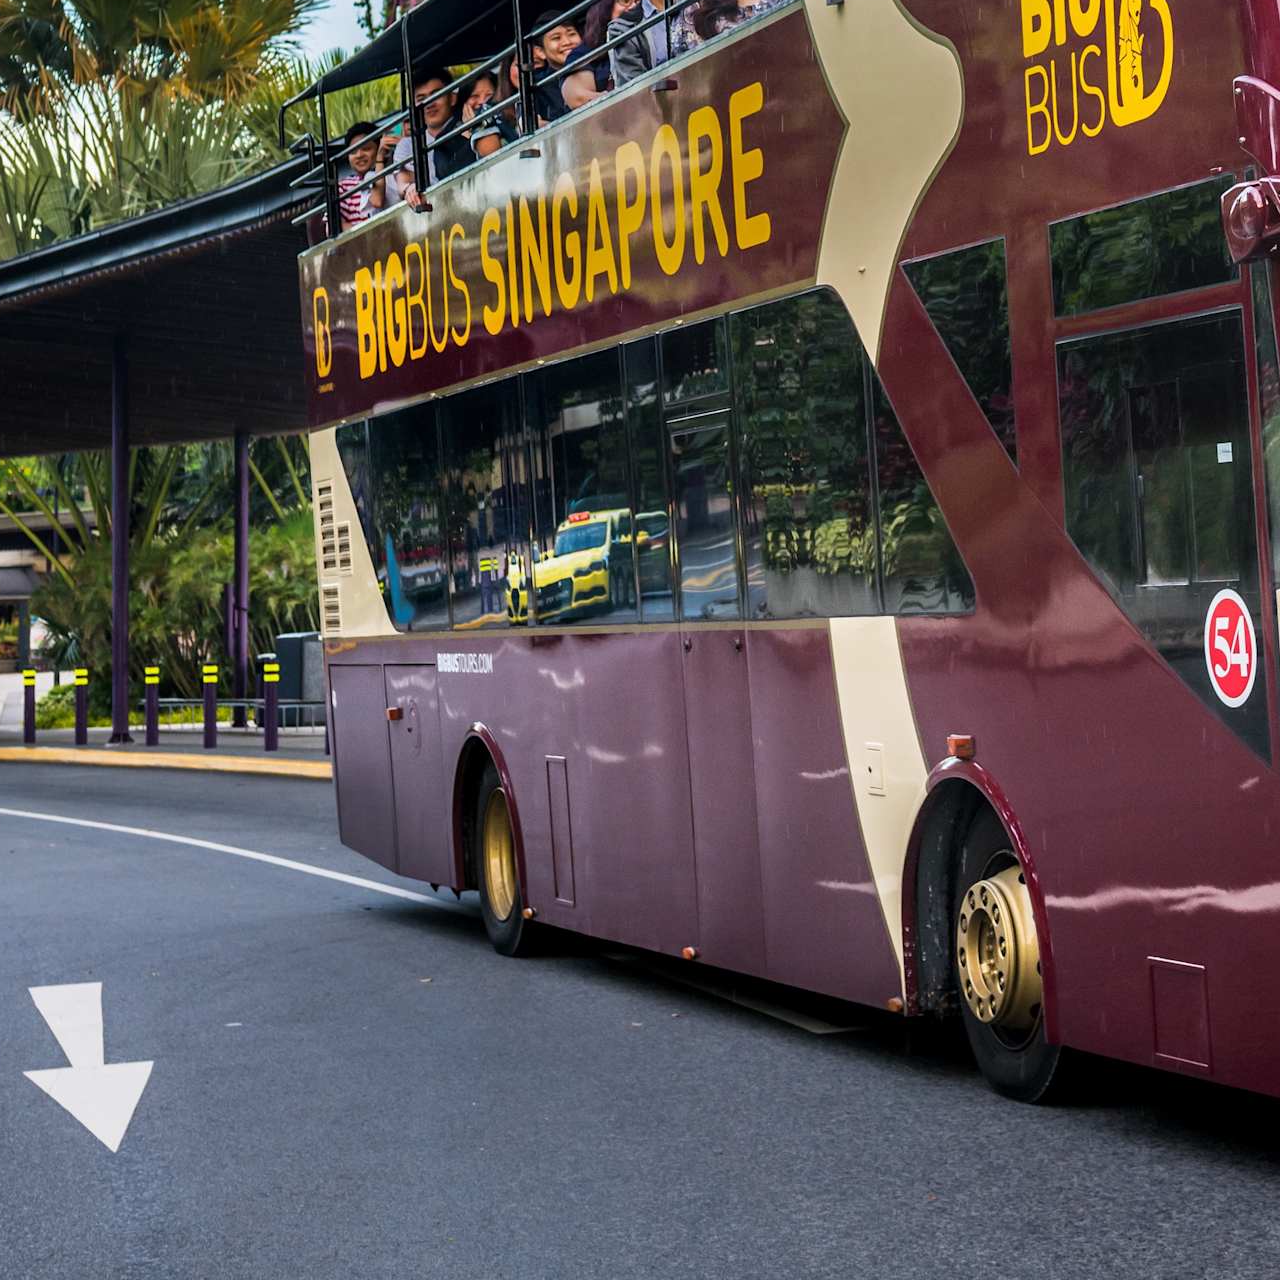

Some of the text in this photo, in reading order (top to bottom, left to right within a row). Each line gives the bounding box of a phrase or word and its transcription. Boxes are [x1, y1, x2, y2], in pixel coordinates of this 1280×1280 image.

[1024, 44, 1106, 156] BUS
[480, 82, 771, 335] SINGAPORE
[1215, 615, 1249, 678] 54
